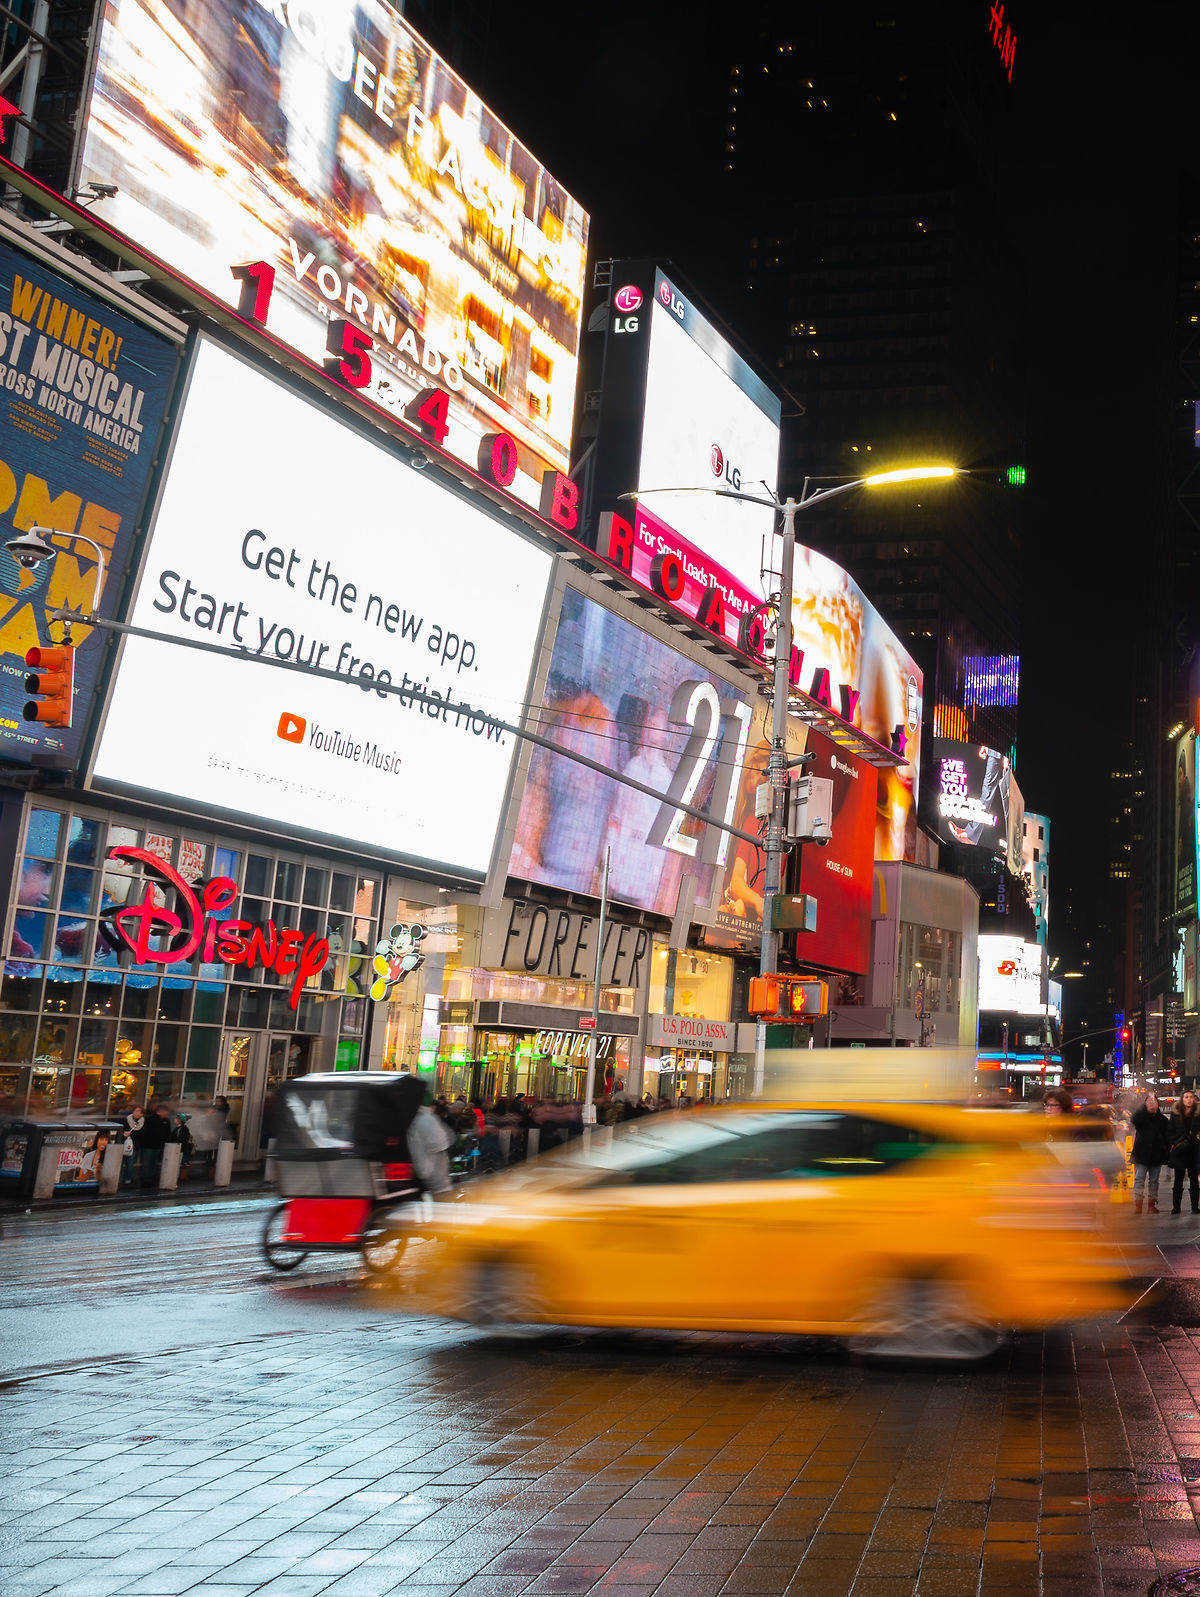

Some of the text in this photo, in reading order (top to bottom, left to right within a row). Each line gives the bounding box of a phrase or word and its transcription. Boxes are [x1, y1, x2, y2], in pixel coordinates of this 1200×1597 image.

[289, 236, 463, 392] VORNADO
[670, 293, 684, 320] LG
[11, 274, 124, 371] WINNER!
[614, 316, 640, 333] LG
[30, 335, 146, 433] MUSICAL
[231, 260, 518, 487] 1540
[37, 385, 83, 425] NORTH
[83, 409, 141, 455] AMERICA
[725, 460, 741, 491] LG
[639, 522, 656, 548] For
[682, 554, 708, 587] Loads
[727, 589, 742, 612] Are
[241, 529, 479, 673] Get the new app.
[2, 664, 24, 677] NOW
[152, 570, 506, 747] Start your free trial now.
[308, 722, 402, 775] YouTube Music
[652, 680, 754, 867] 21
[941, 758, 965, 773] WE
[941, 770, 967, 784] GET
[941, 780, 968, 797] YOU
[826, 859, 841, 874] HOUSE
[716, 914, 729, 924] LIVE
[500, 898, 649, 988] FOREVER
[662, 1017, 728, 1039] U.S. POLO ASSN.
[596, 1035, 612, 1059] 21
[677, 1038, 713, 1048] SINCE 1890
[57, 1151, 82, 1165] TRESS
